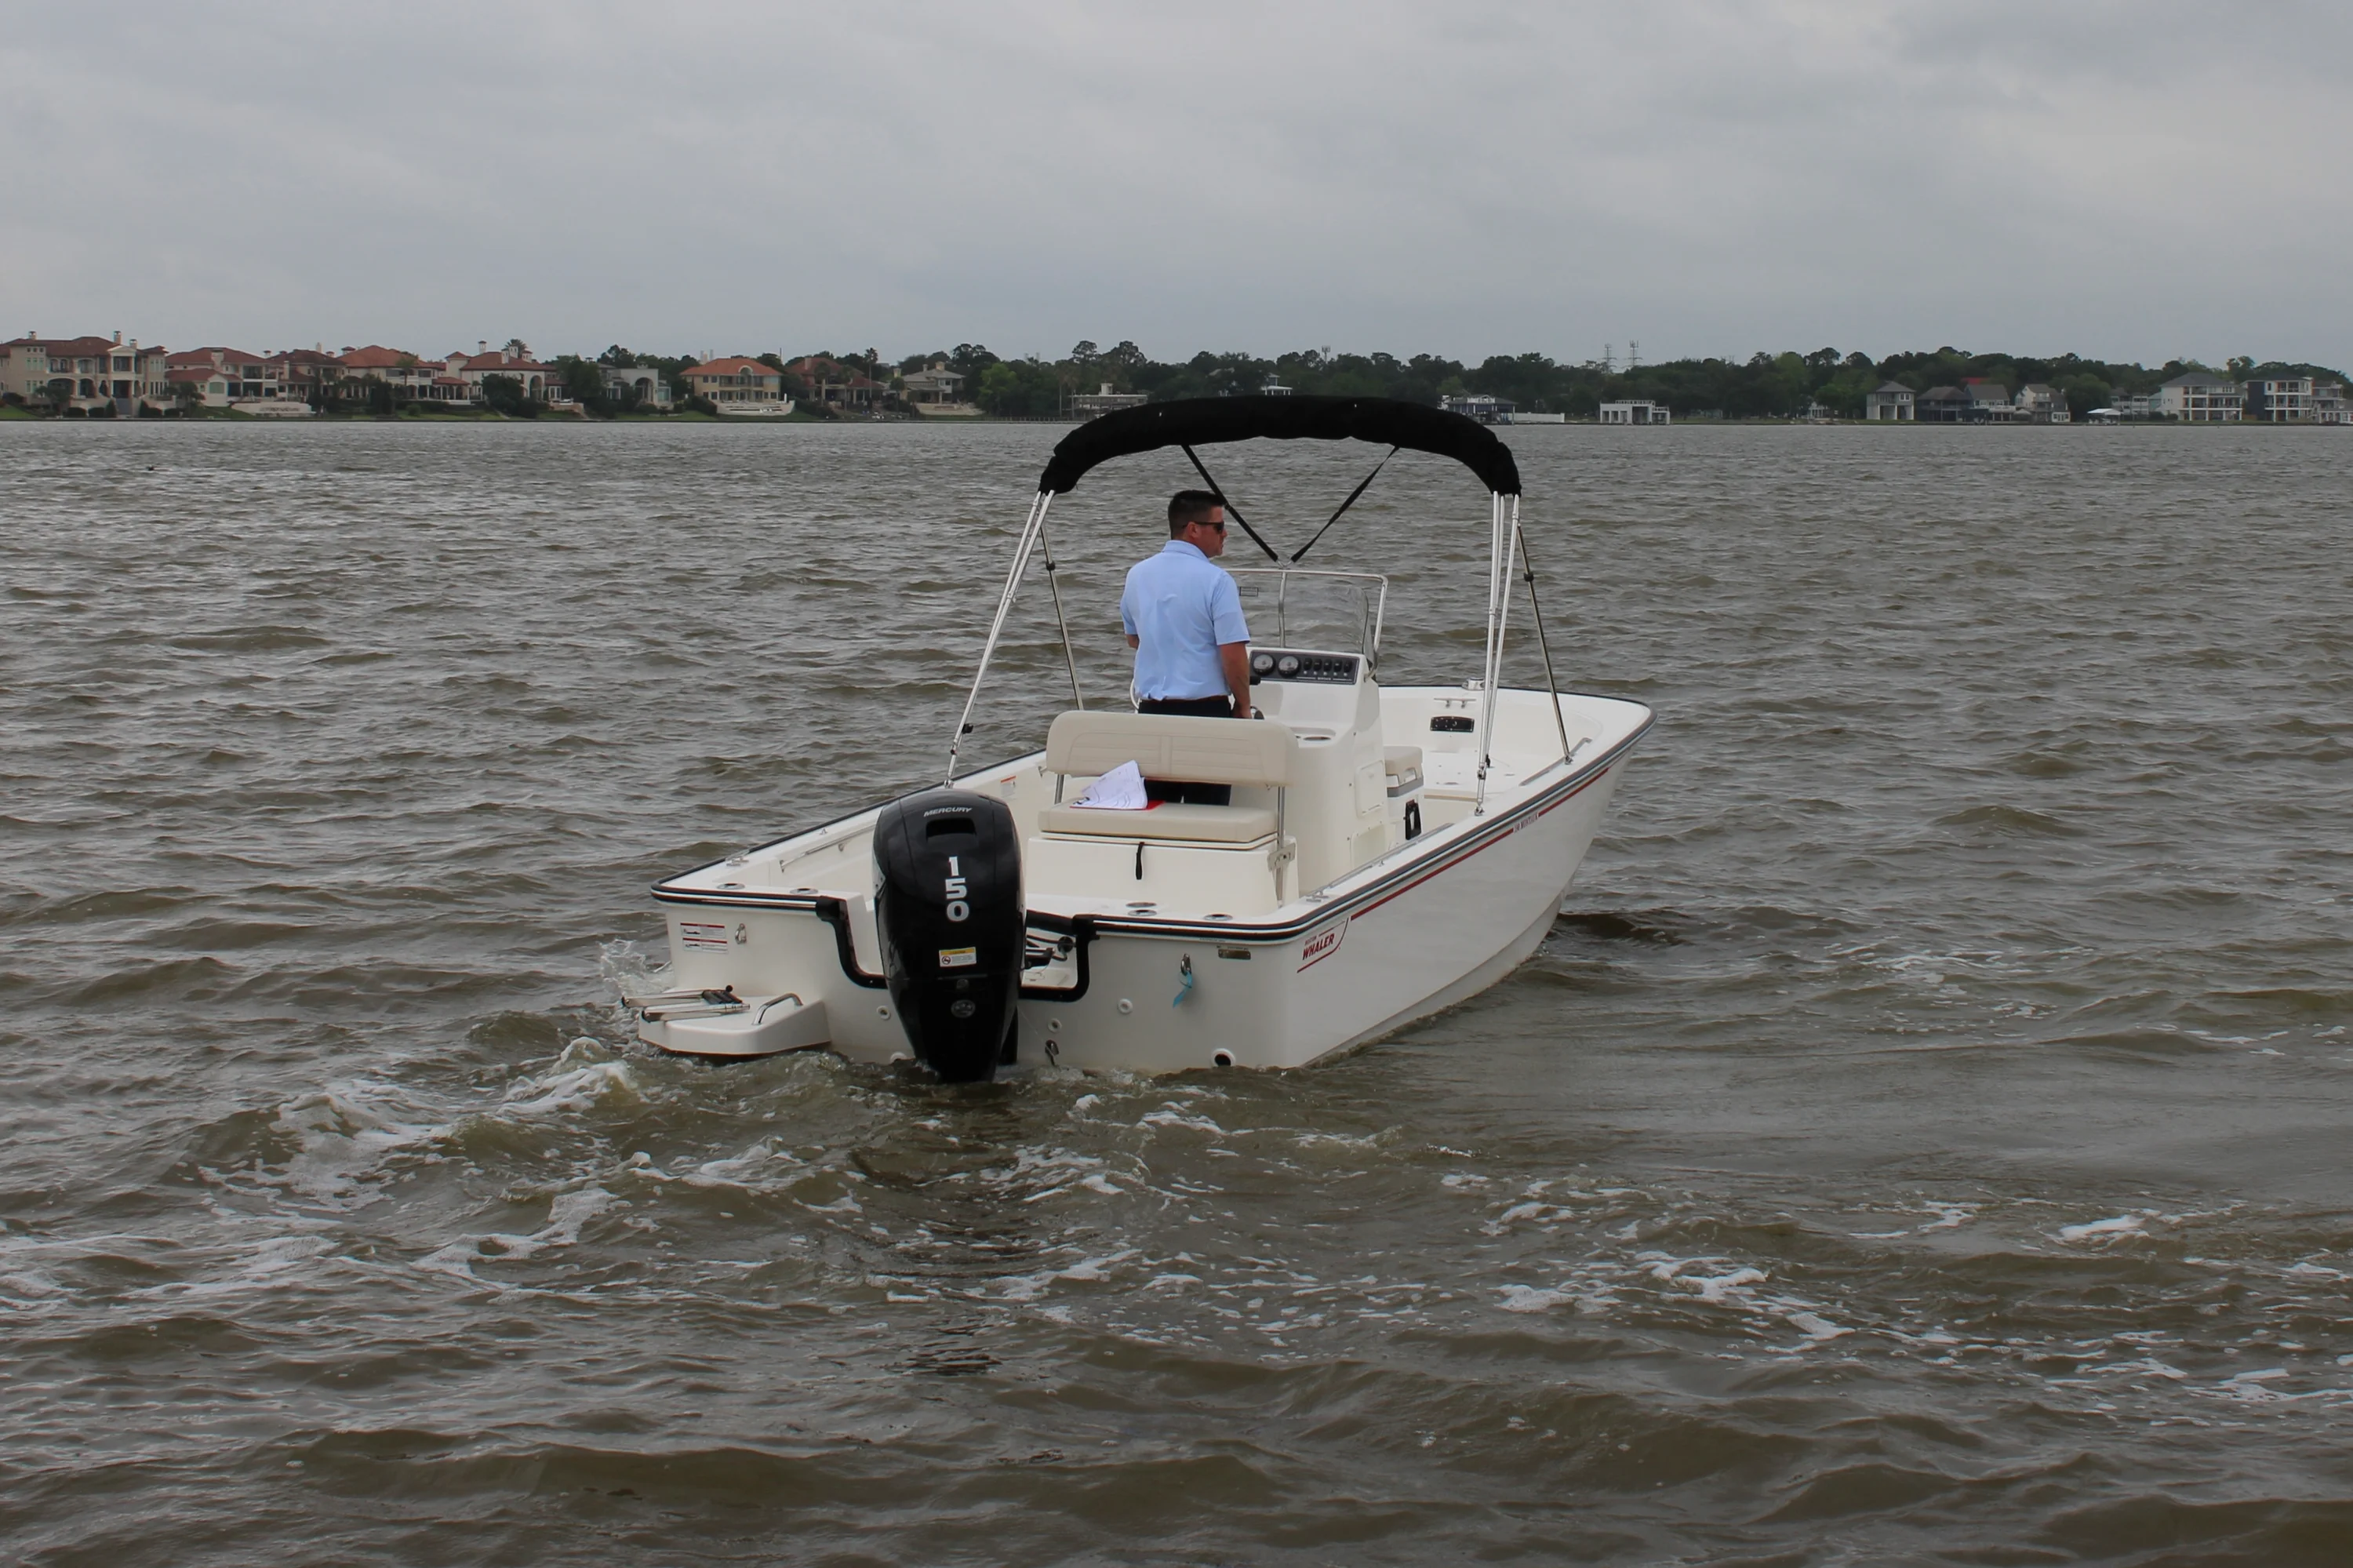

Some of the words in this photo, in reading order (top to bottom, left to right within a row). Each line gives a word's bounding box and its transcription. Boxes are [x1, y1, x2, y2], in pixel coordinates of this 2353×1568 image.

[923, 806, 973, 817] MERCURY
[945, 856, 969, 922] 150
[1302, 933, 1335, 961] WHALER
